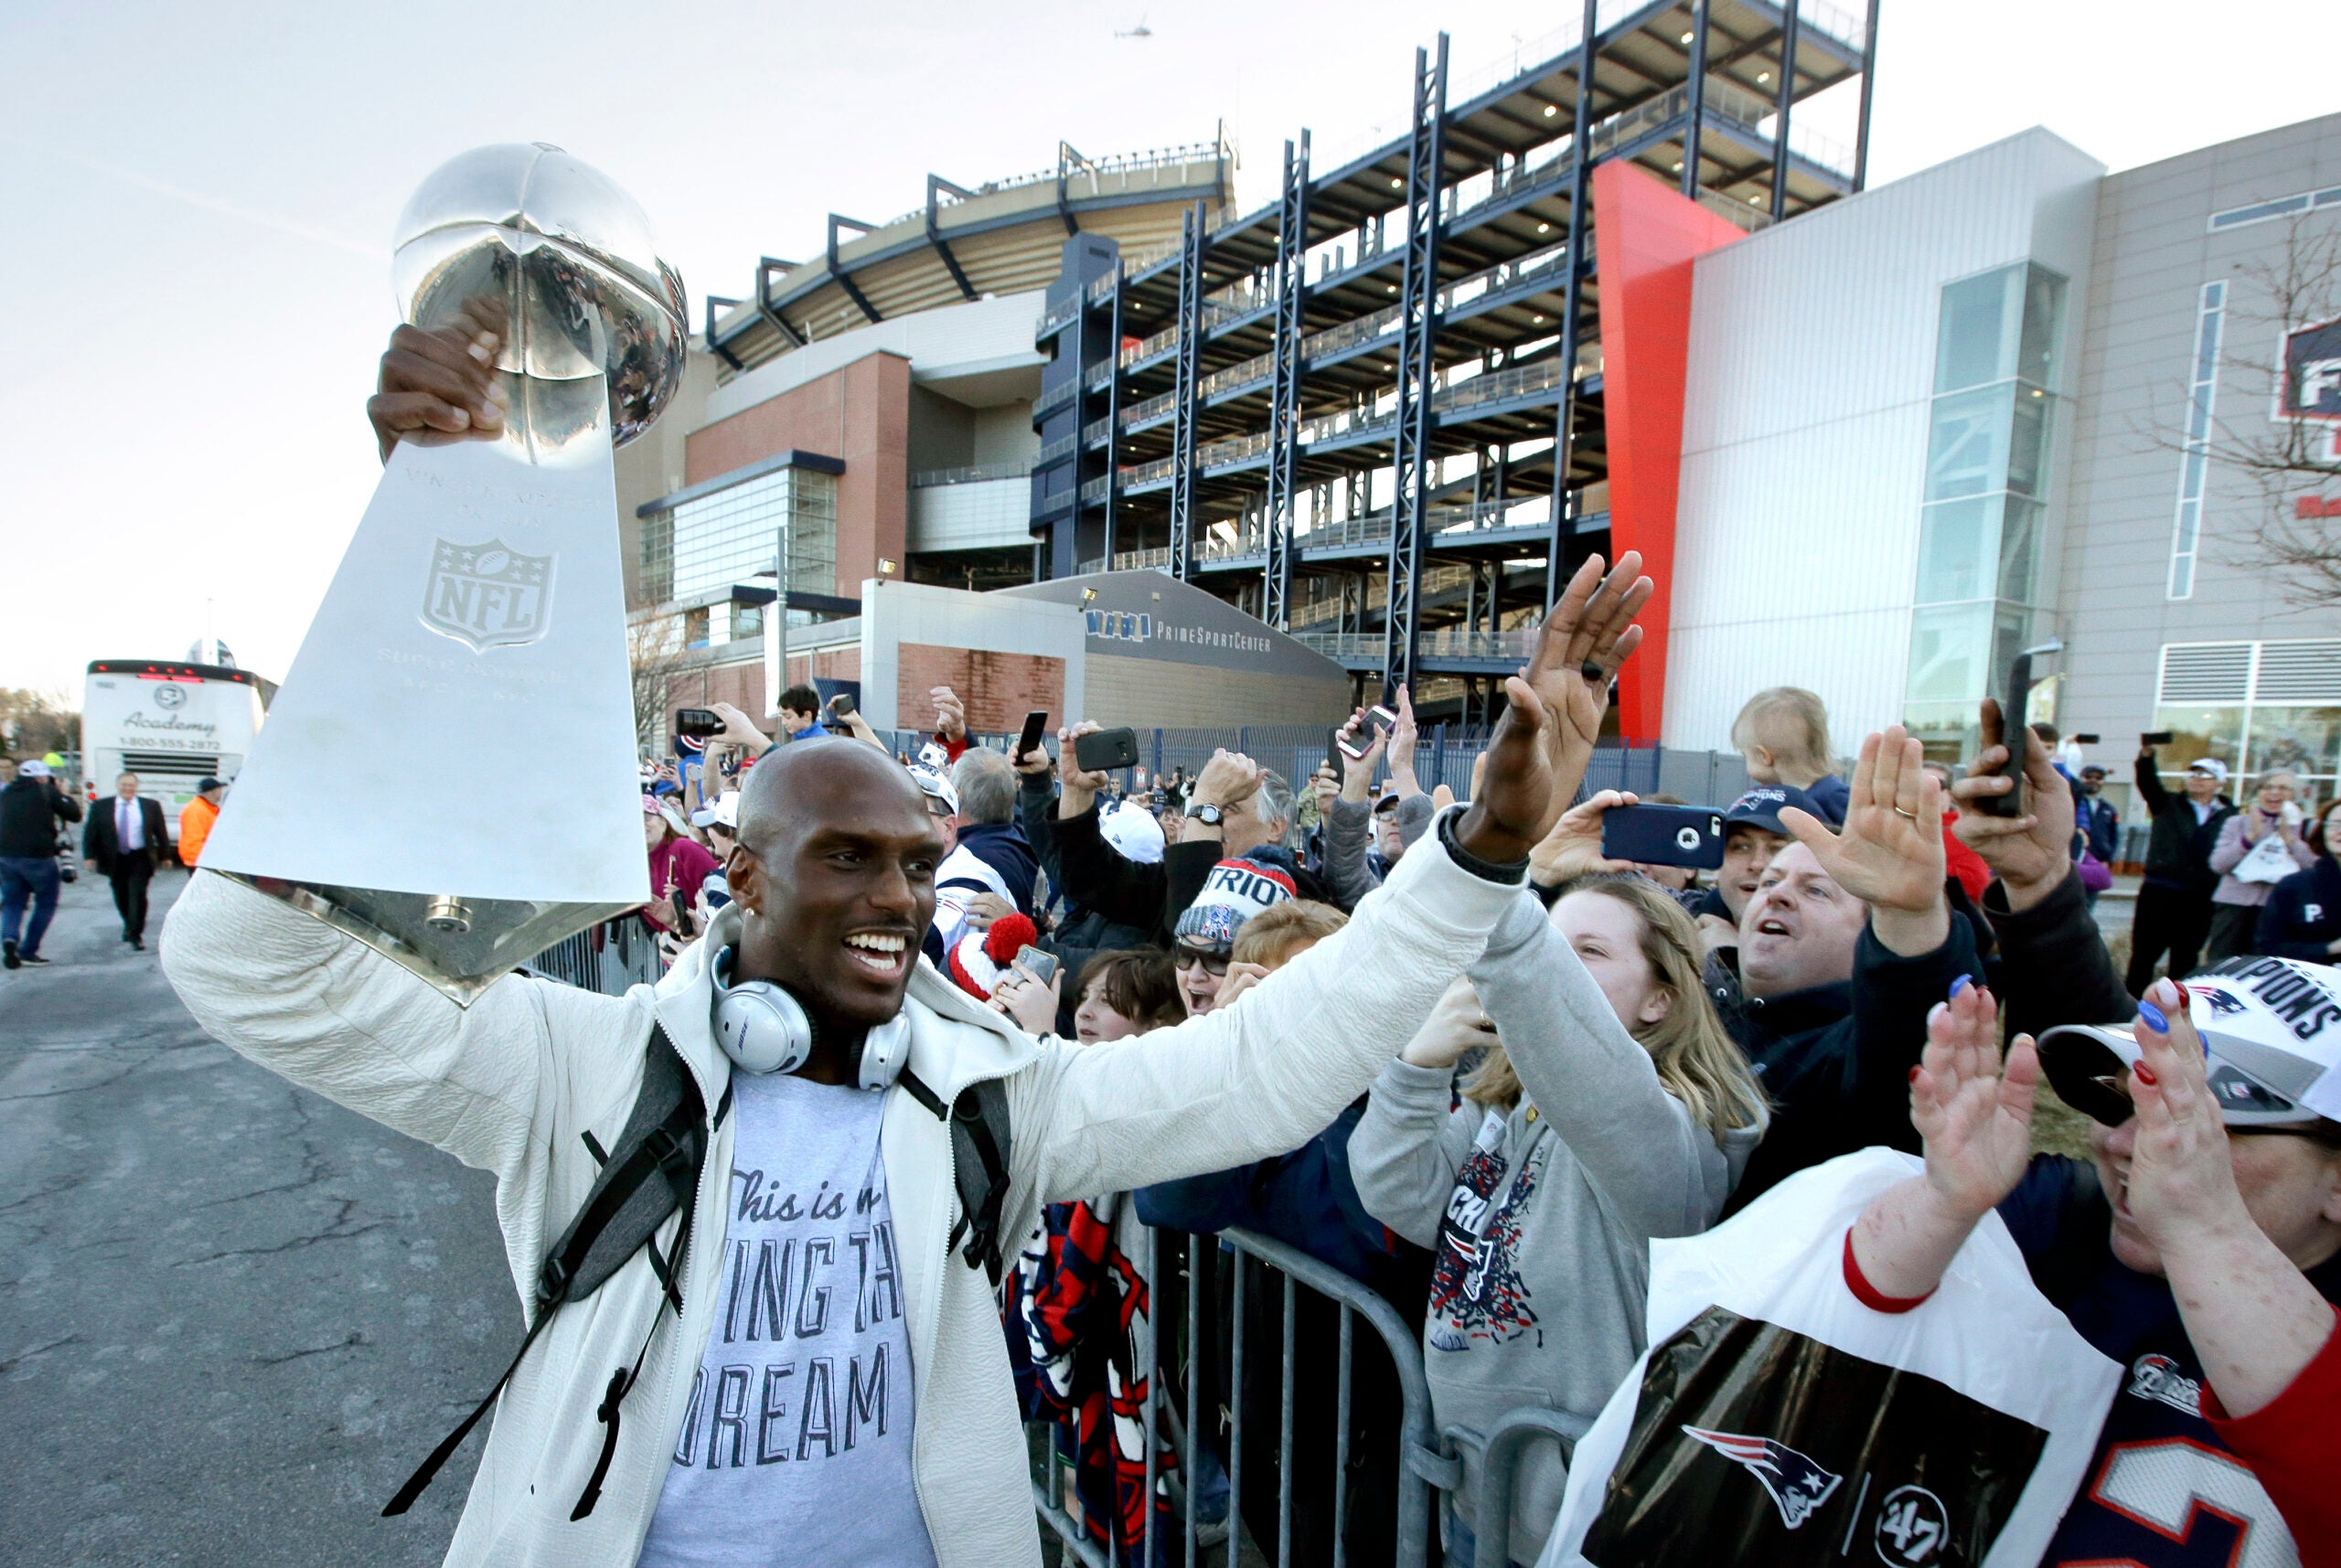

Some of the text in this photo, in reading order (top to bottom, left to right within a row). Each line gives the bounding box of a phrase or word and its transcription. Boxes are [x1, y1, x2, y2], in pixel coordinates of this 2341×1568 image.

[434, 576, 531, 631] NFL
[123, 711, 218, 738] Academy
[2235, 959, 2341, 1040] PIONS
[810, 1180, 848, 1220] is
[721, 1236, 835, 1344] ING
[1881, 1500, 1941, 1563] 47
